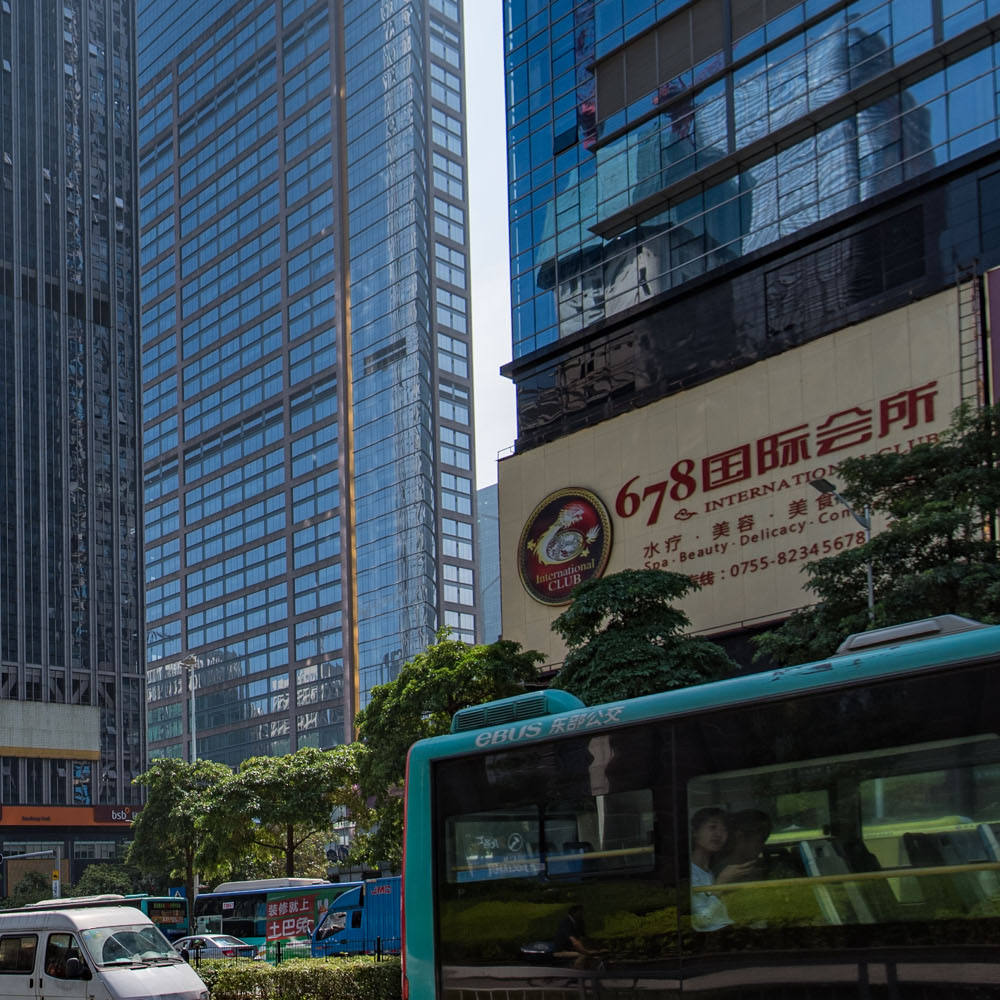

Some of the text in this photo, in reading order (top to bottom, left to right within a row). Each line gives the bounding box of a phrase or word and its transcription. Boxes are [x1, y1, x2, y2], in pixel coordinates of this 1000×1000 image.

[704, 453, 867, 513] INTERNATION
[679, 540, 729, 562] Beauty
[740, 519, 806, 547] Delicacy
[536, 558, 595, 584] International
[548, 574, 582, 591] CLUB
[111, 810, 127, 820] bsb
